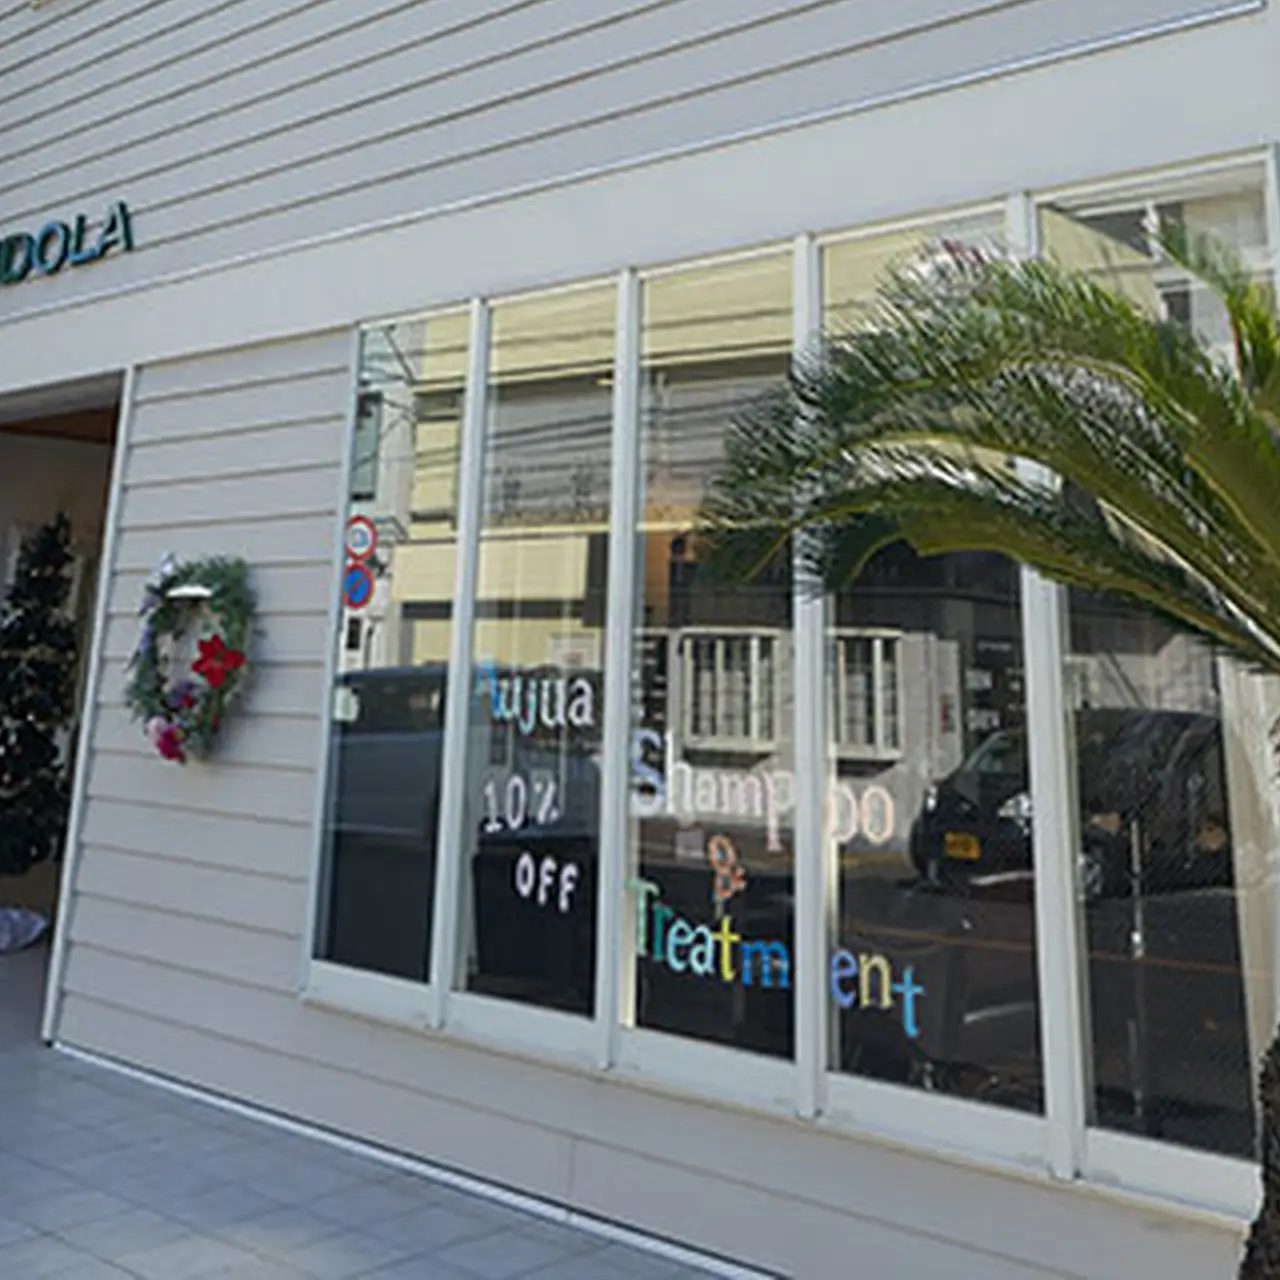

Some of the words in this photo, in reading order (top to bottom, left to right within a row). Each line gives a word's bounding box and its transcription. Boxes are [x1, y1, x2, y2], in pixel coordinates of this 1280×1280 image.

[484, 775, 559, 833] 10%
[515, 851, 579, 912] OFF
[624, 876, 924, 1038] Treatment
